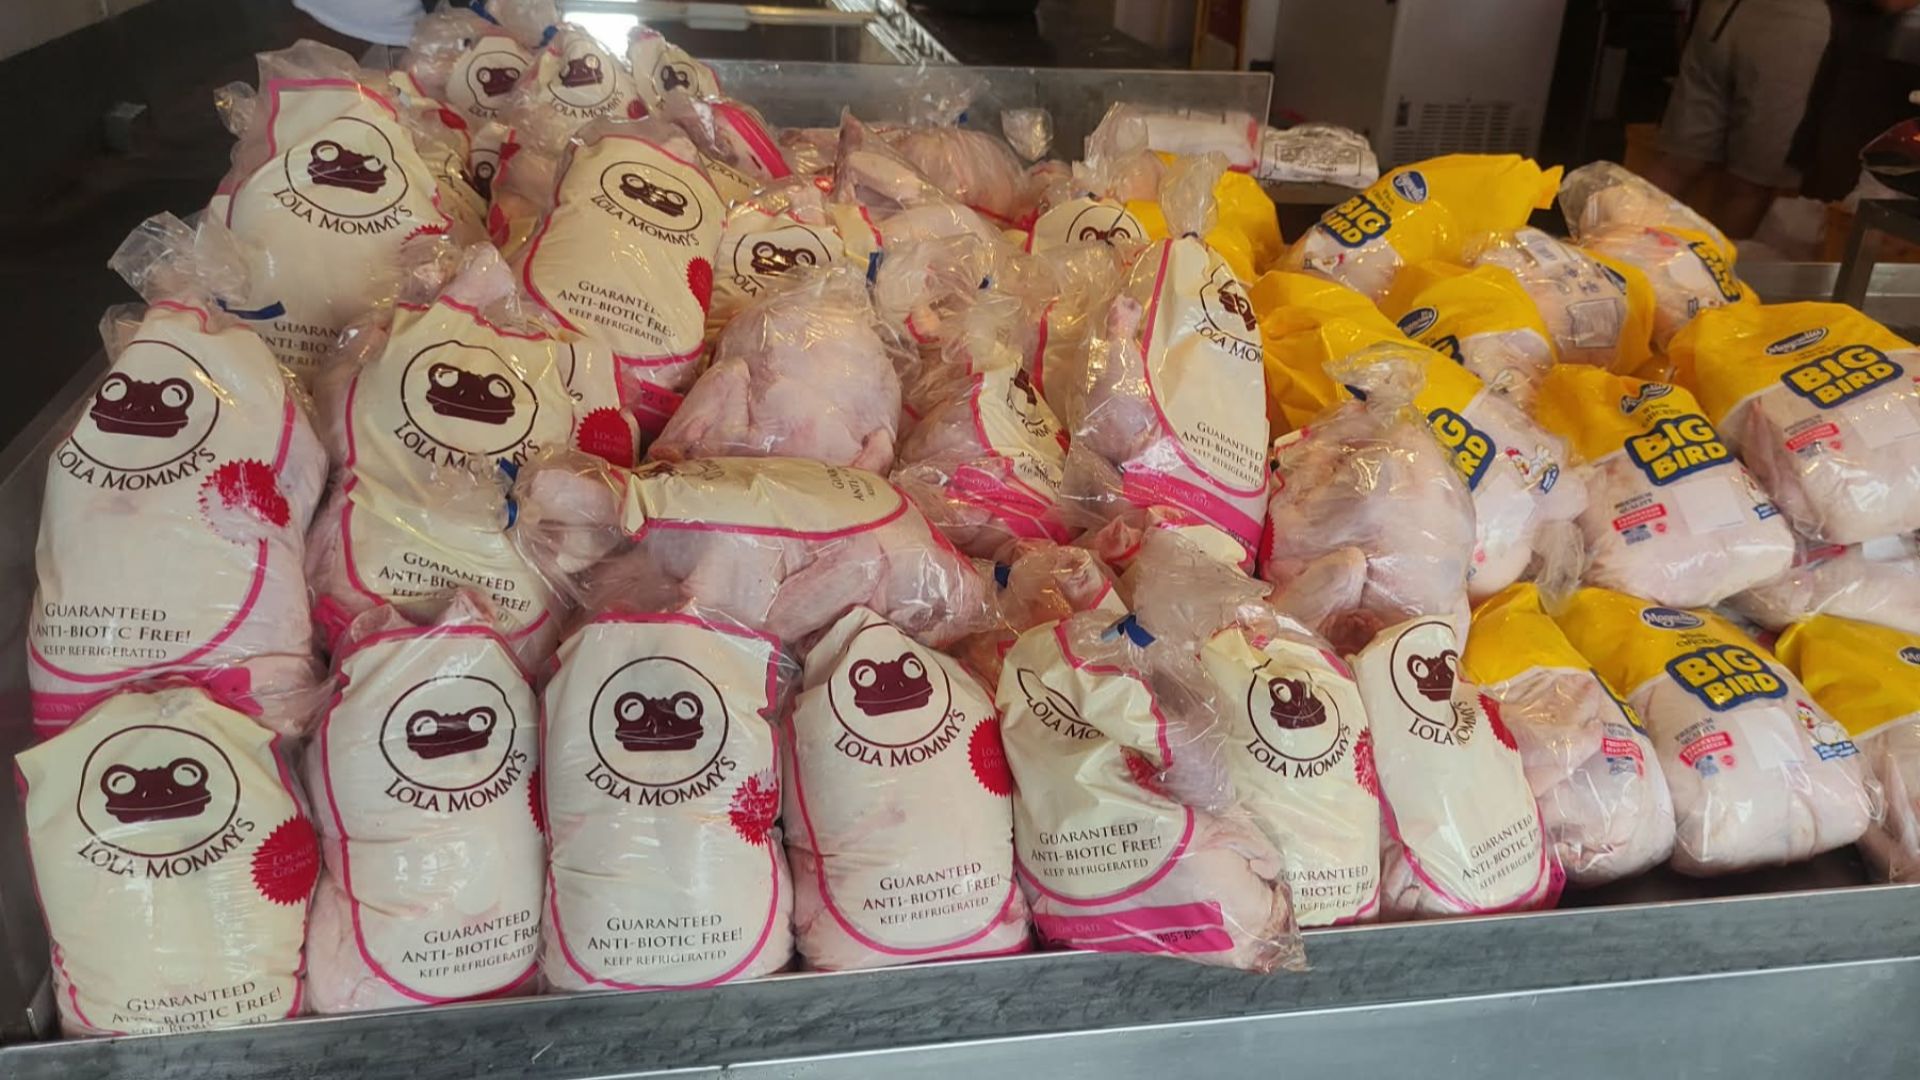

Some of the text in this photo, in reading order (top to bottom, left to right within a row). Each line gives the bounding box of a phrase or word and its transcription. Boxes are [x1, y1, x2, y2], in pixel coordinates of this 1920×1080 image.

[273, 188, 413, 236] LOLA MOMMY'S
[591, 194, 699, 247] LOLA MOMMY'S
[1337, 195, 1387, 235] BIG
[731, 274, 758, 297] OLA
[557, 289, 645, 325] ANTI-BIOTIC
[274, 321, 341, 339] GUARAN
[1788, 347, 1879, 393] BIG
[1813, 362, 1896, 405] BIRD
[394, 420, 437, 464] LOLA
[1181, 431, 1247, 467] ANTI-BIOTIC
[1196, 421, 1263, 462] GUARANTEED
[1630, 417, 1716, 464] BIG
[57, 441, 216, 491] LOLA MOMMY'S
[1650, 441, 1728, 481] BIRD
[403, 552, 516, 592] GUARANTEED
[45, 602, 167, 623] GUARANTEED
[35, 624, 191, 644] ANTI-BIOTC FREE!
[68, 645, 167, 660] REFRIGERATED
[1673, 648, 1762, 689] BIG
[1702, 672, 1781, 706] BIRD
[834, 708, 966, 768] LOLA MOMMY'S
[1408, 716, 1455, 746] LOLA
[1246, 723, 1351, 779] LOLA MOMMY'S
[385, 748, 527, 813] LOLA MOMMY'S
[585, 756, 737, 807] LOLA MOMMY'S
[77, 817, 255, 879] LOLA MOMMY'S
[1031, 835, 1162, 862] ANTI-BIOTIC FREE!
[1039, 822, 1138, 846] GUARANTEED
[880, 862, 982, 891] GUARANTEED
[1043, 856, 1149, 878] KEEP REFRIGERATED
[863, 874, 1001, 911] ANTI-BIOTIC FREE!
[1294, 885, 1352, 898] -BIOTIC
[424, 909, 531, 944] GUARANTEED
[606, 914, 722, 932] GUARANTEED
[880, 896, 989, 926] KEEP REFRIGERATED
[402, 934, 510, 963] ANTI-BIOTIC
[587, 927, 743, 951] ANTI-BIOTIC FREE!
[420, 943, 536, 979] KEEP REFRIGERATED
[604, 949, 727, 967] KEEP REFRIGERATED
[127, 980, 256, 1013] GUARANTEED
[235, 985, 282, 1014] FREE!
